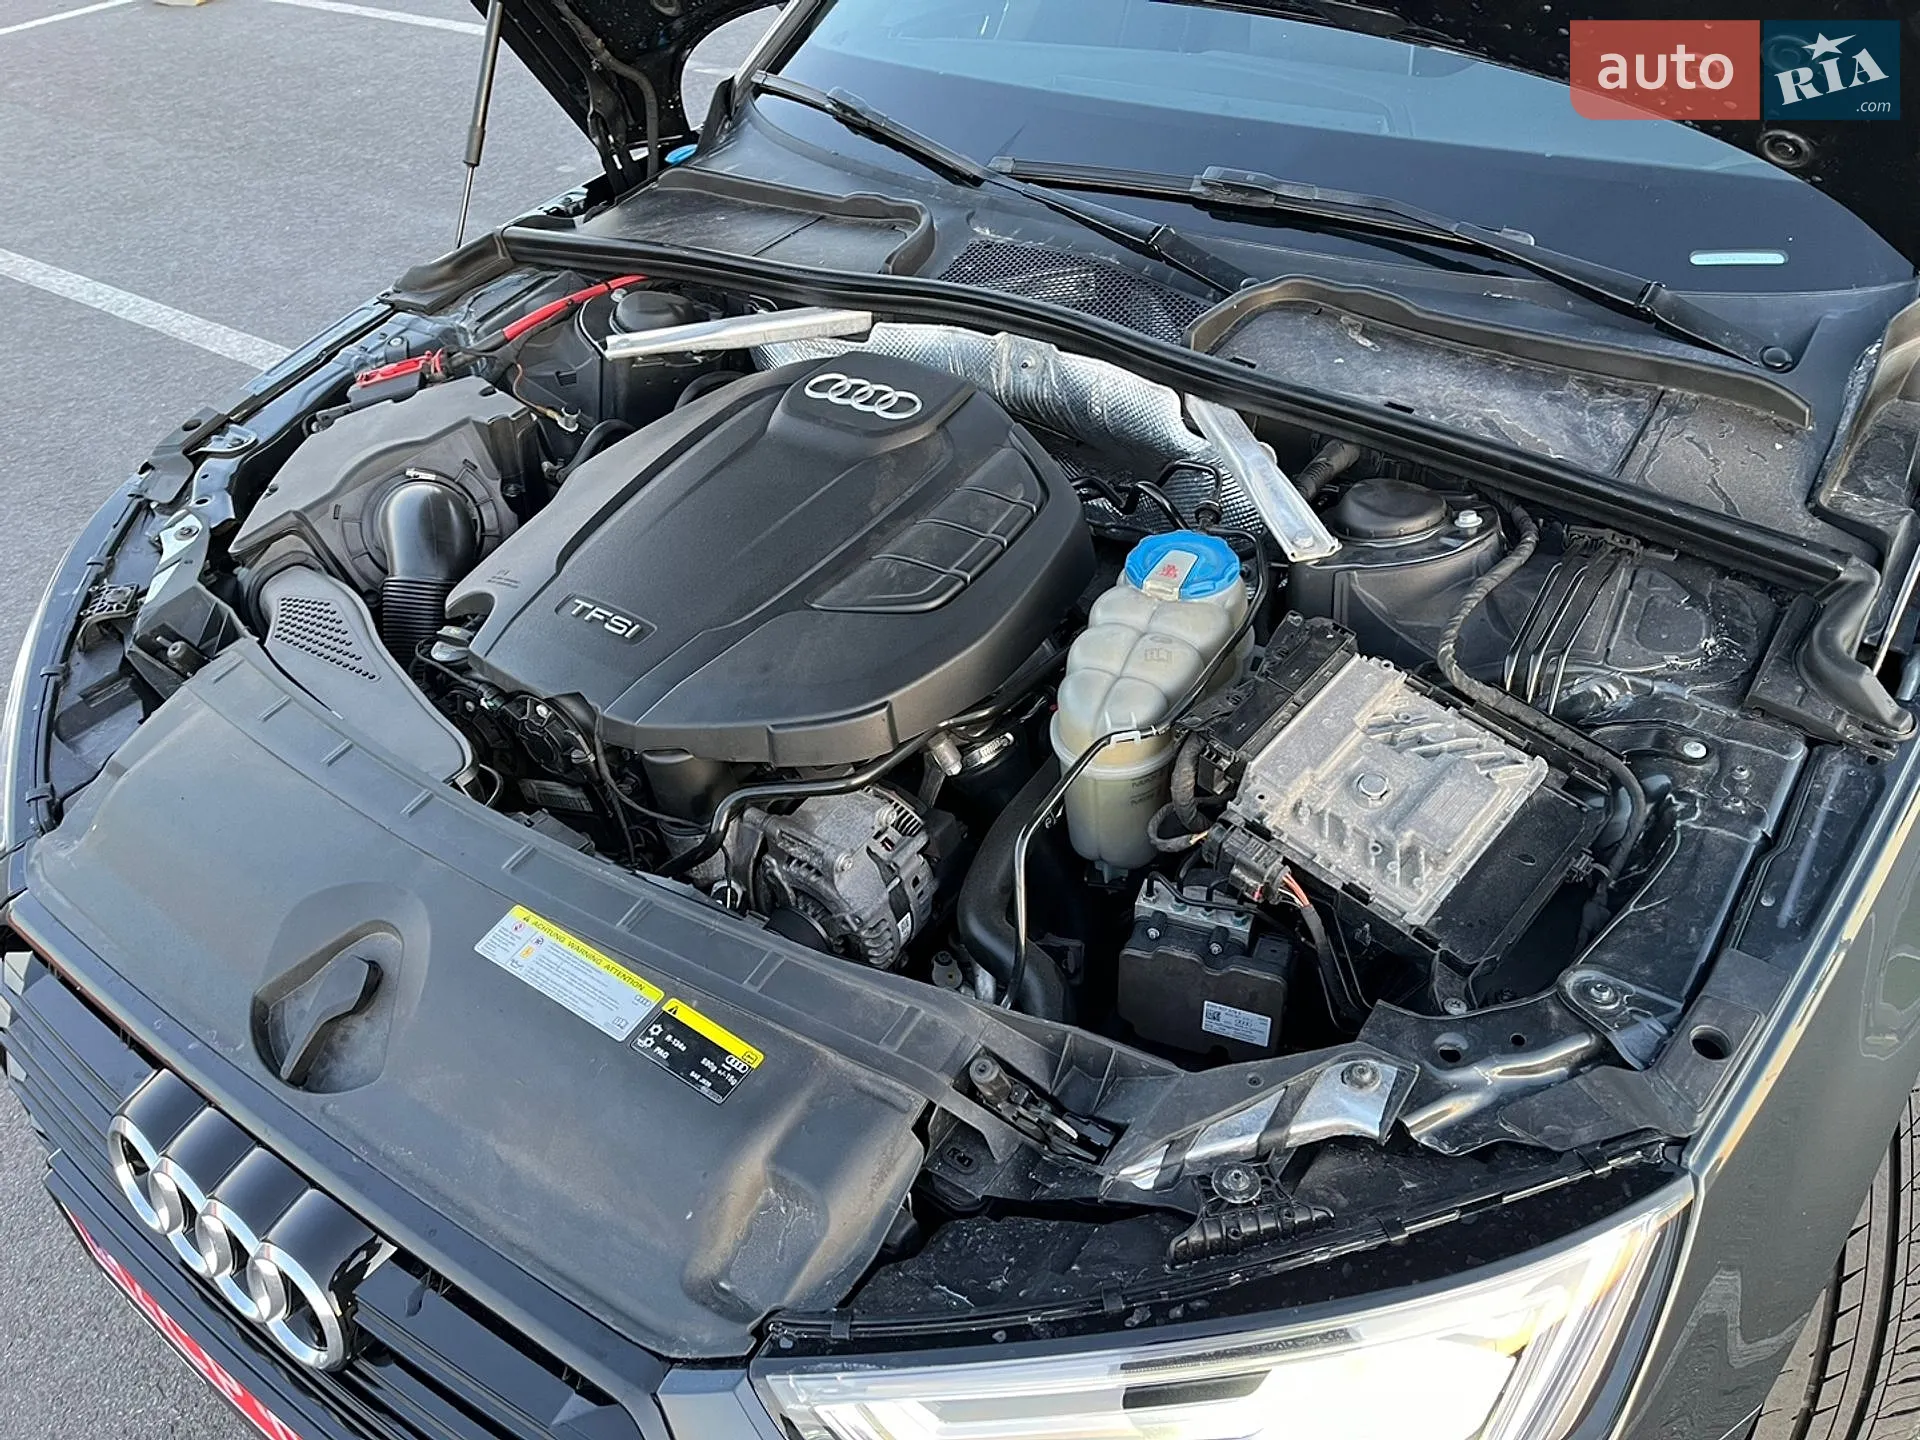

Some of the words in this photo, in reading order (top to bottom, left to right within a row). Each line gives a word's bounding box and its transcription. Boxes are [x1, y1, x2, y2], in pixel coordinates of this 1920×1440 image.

[571, 599, 642, 639] TFSI
[532, 919, 566, 944] ACHTUNG
[567, 940, 603, 966] WARNING
[603, 963, 646, 992] ATTENTION
